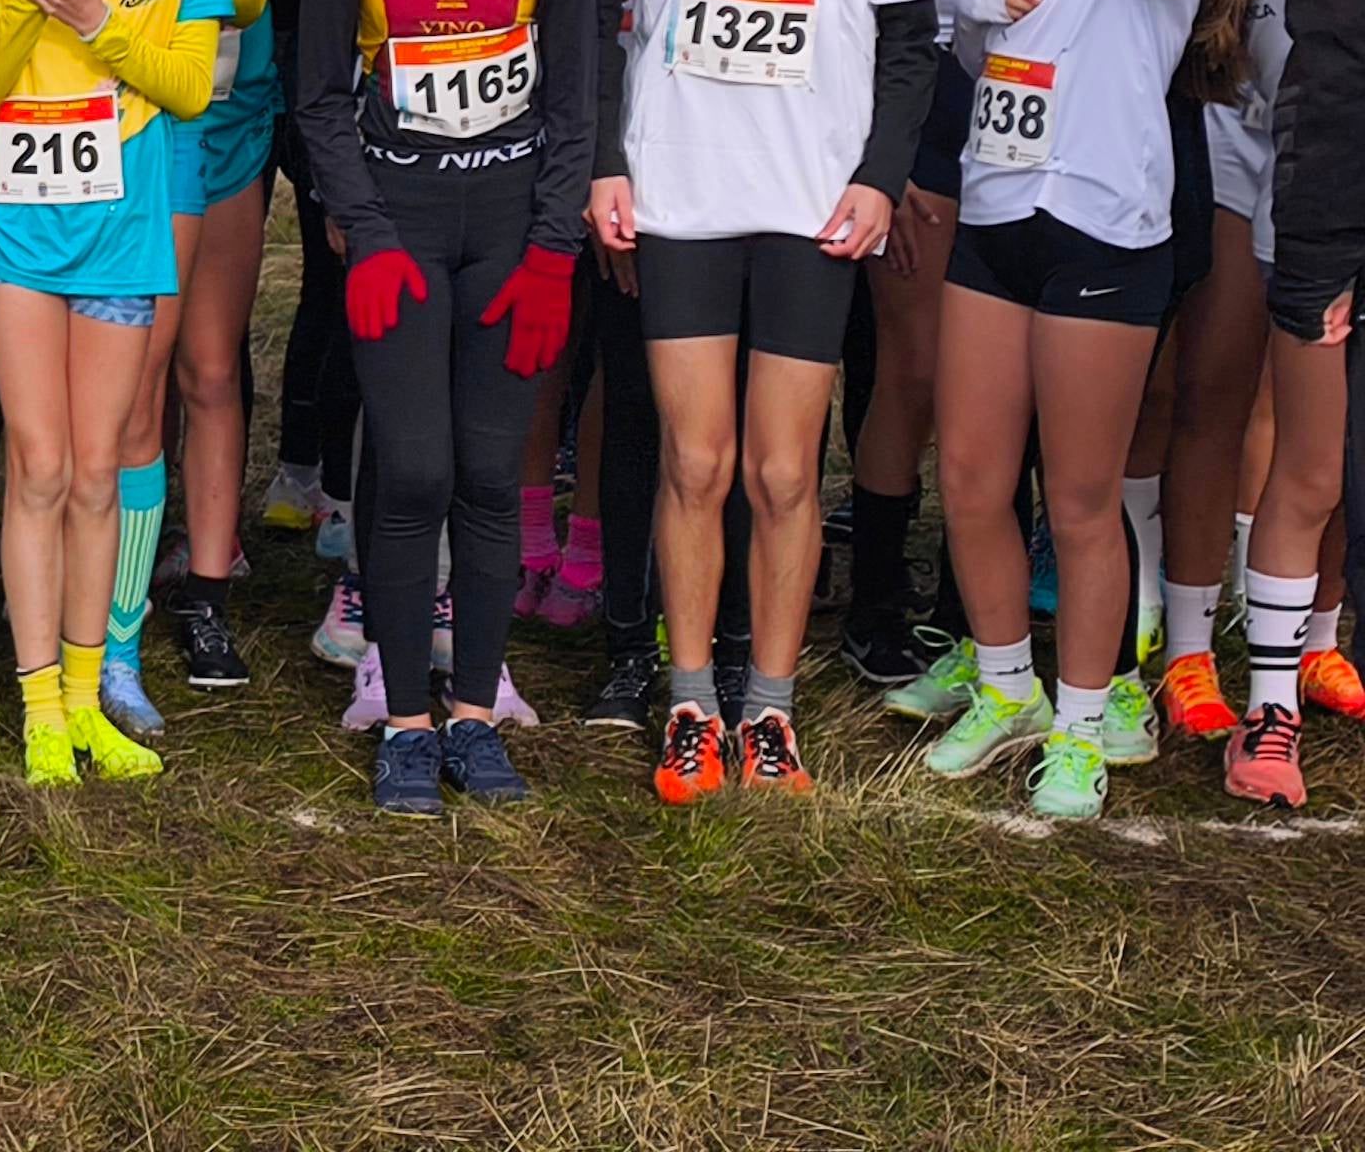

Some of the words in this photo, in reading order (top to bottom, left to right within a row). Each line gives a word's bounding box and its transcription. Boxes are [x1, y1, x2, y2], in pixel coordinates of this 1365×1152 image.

[685, 1, 808, 55] 1325
[415, 52, 530, 114] 1165
[11, 130, 99, 175] 216
[438, 137, 536, 169] NIKE
